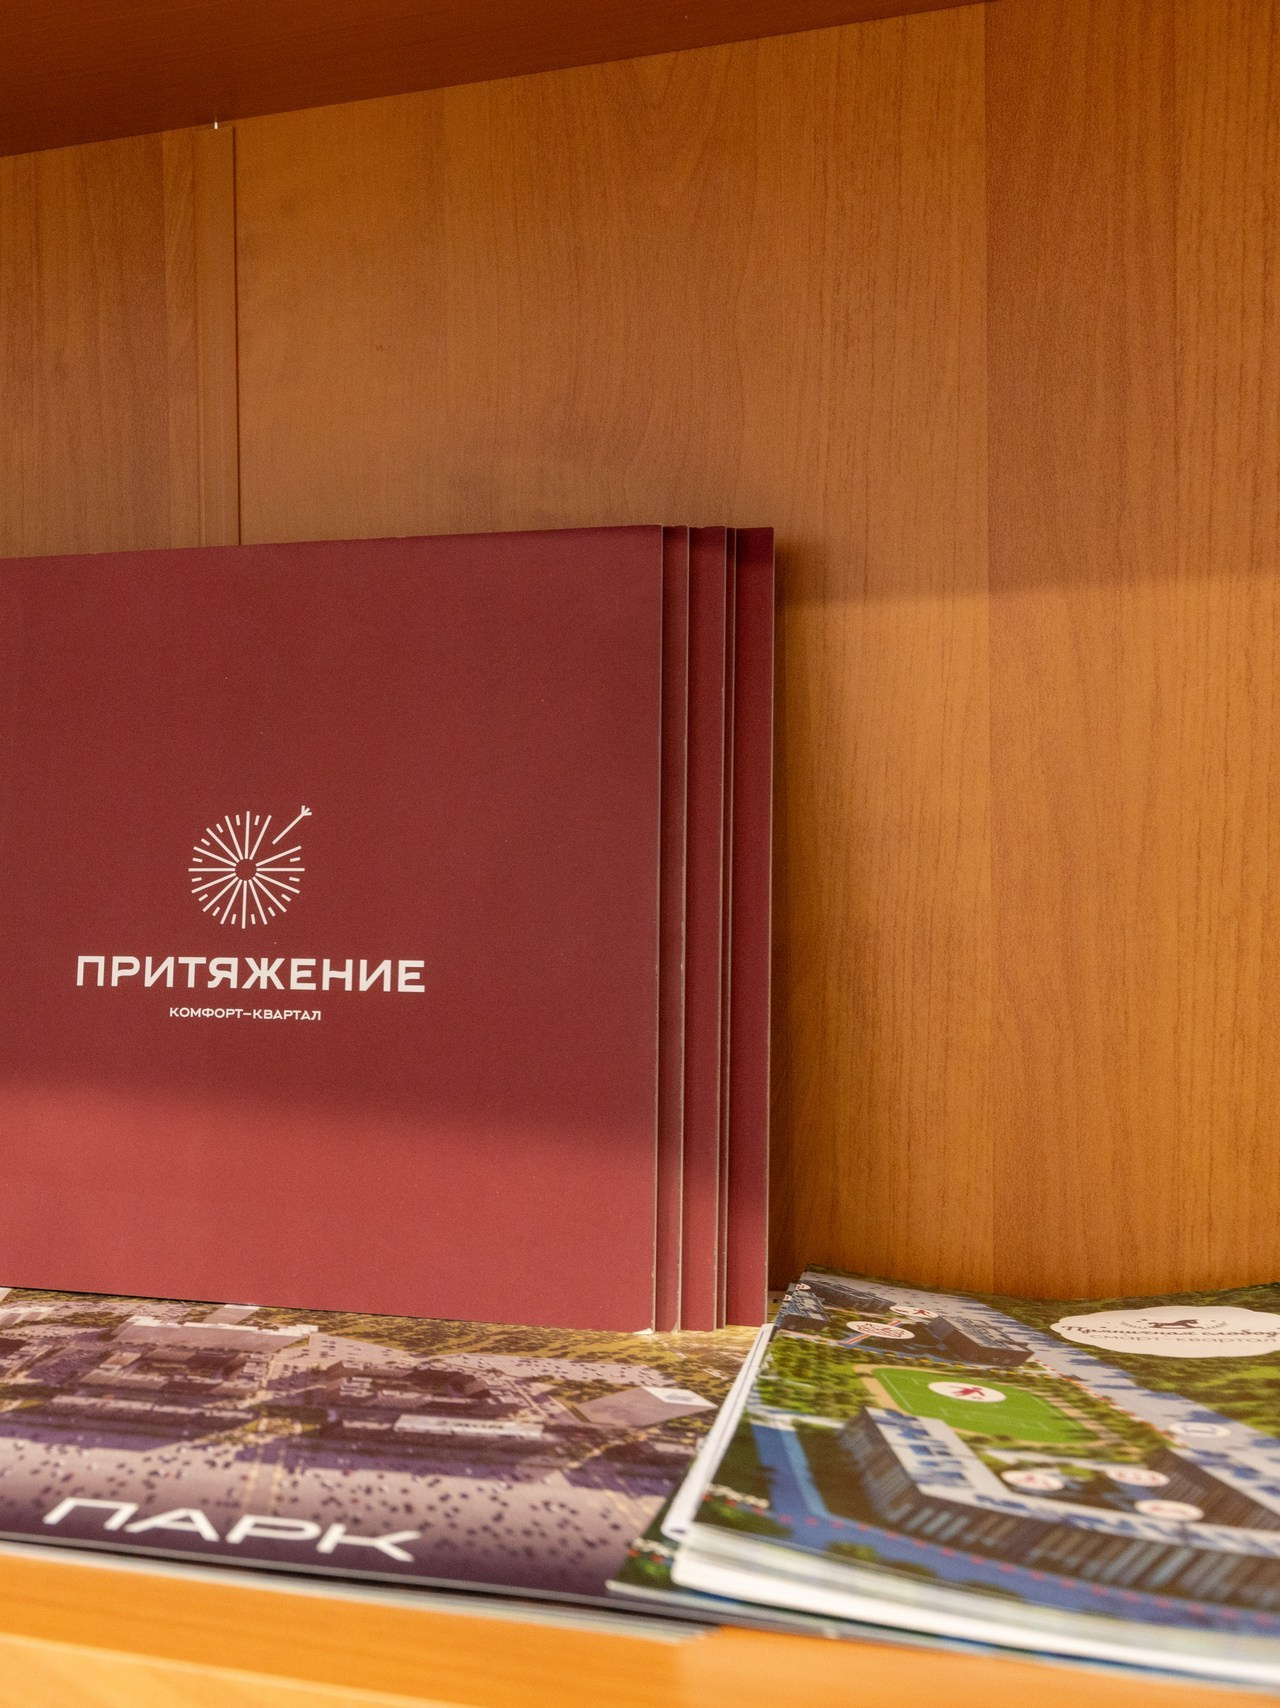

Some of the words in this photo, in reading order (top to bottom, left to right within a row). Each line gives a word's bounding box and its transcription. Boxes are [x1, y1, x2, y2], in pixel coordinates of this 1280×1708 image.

[76, 955, 426, 993] ПРИТЯЖЕНИЕ
[169, 1006, 322, 1021] КОМФОРТ-КВАРТАЛ
[42, 1497, 422, 1564] ПАРК
